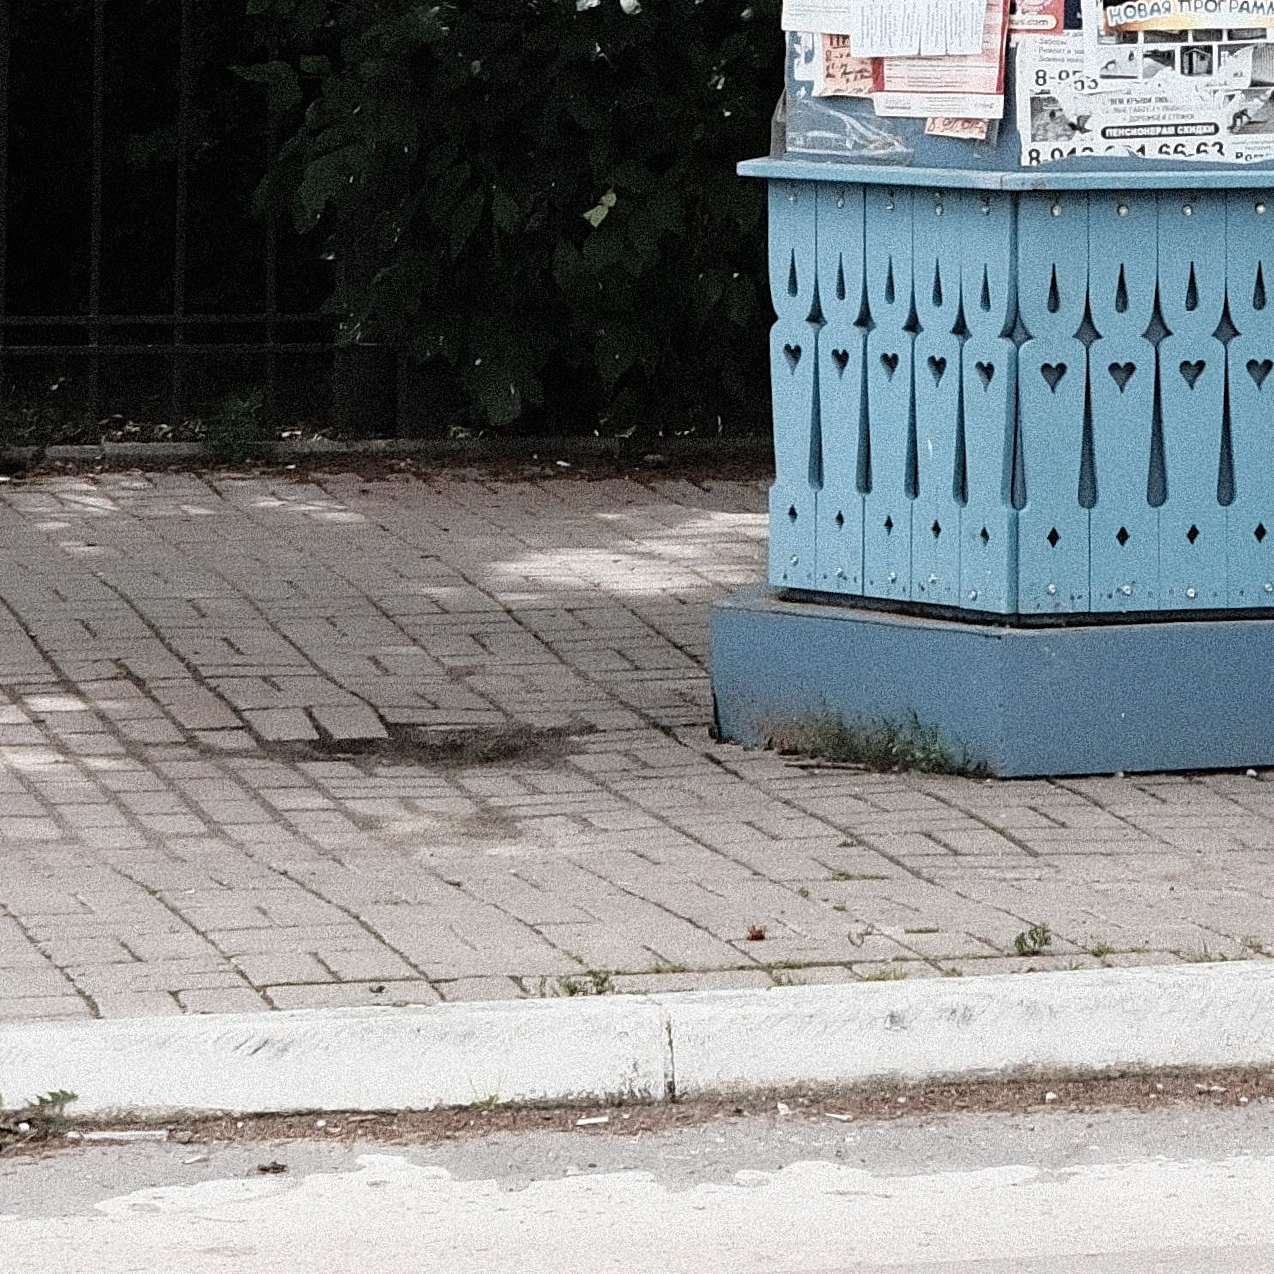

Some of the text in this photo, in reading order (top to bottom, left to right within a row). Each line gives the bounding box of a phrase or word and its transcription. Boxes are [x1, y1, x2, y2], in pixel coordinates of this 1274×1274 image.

[1109, 1, 1172, 25] НОВАЯ
[1105, 124, 1216, 138] ПЕНСИОНЕРАМ СКИДКИ
